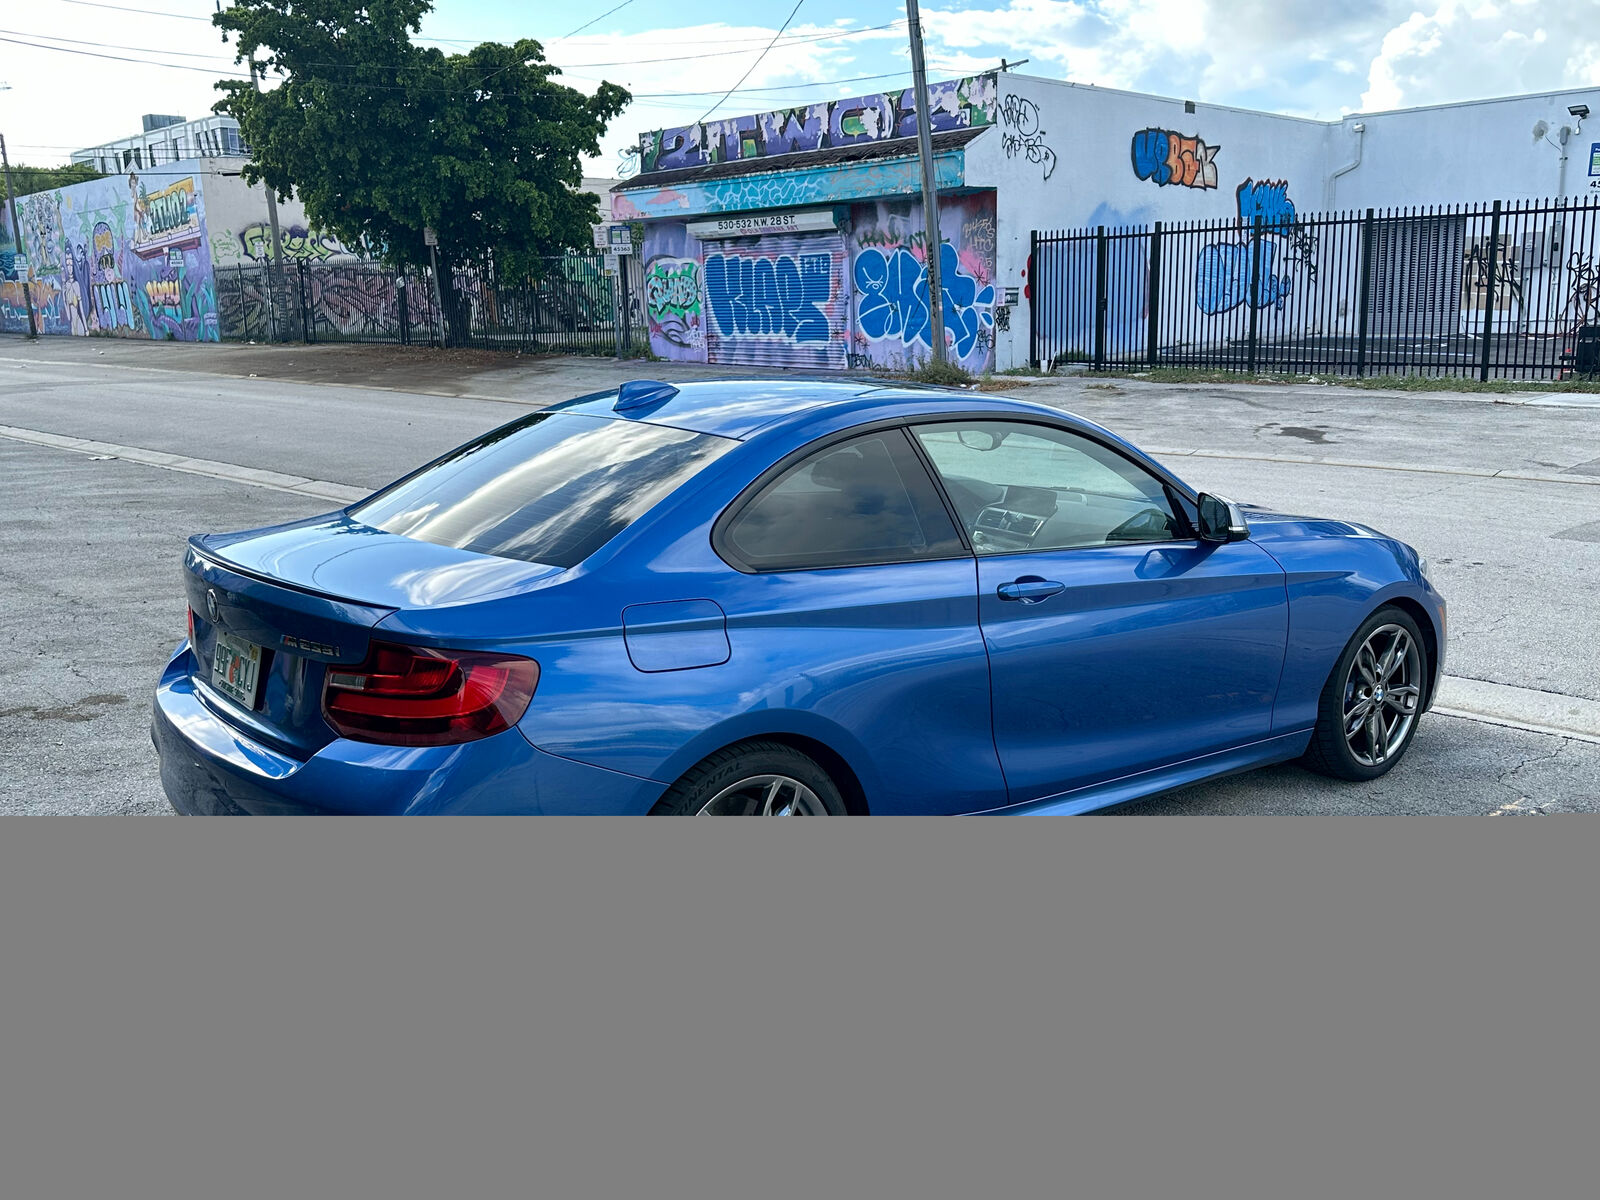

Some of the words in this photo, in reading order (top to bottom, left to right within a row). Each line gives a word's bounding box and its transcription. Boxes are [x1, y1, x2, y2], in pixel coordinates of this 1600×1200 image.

[718, 220, 752, 230] 530-532
[753, 218, 768, 227] N.W.
[770, 216, 781, 225] 28
